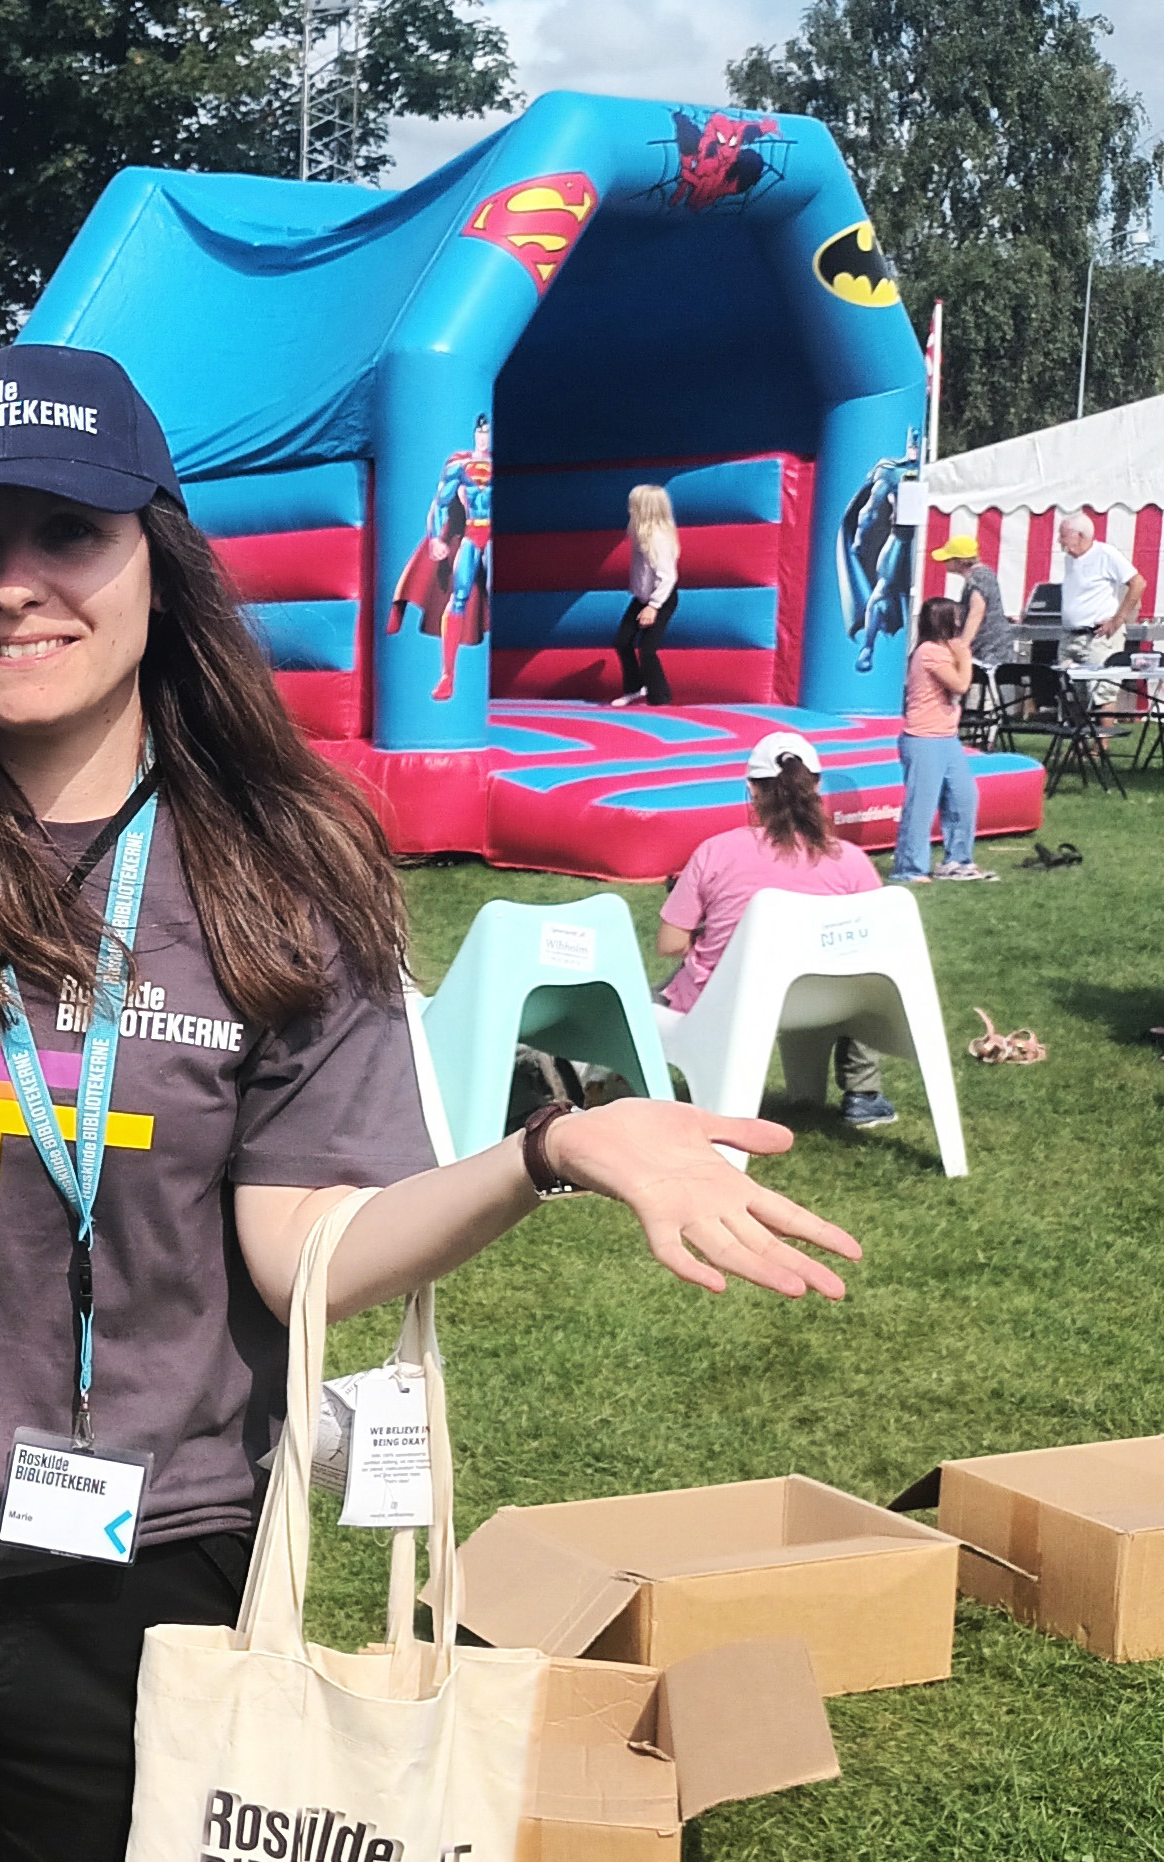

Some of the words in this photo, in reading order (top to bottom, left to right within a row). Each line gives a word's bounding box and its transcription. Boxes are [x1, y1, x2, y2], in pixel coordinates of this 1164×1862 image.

[111, 831, 145, 928] BIBLIOTEKERNE
[820, 928, 869, 948] NIRU
[55, 1002, 245, 1052] BIOTEKERNE
[11, 1049, 58, 1150] BIBLIOTEKERNE
[82, 1037, 110, 1142] BIBLIOTEKERNE
[80, 1141, 97, 1200] Roskilde
[370, 1427, 384, 1435] WE
[386, 1426, 420, 1435] BELIEVE
[373, 1438, 400, 1447] BEING
[402, 1437, 426, 1446] OKAY
[18, 1449, 70, 1472] Roskilde
[15, 1465, 108, 1496] BIBLIOTEKERNE
[8, 1510, 34, 1522] Marie
